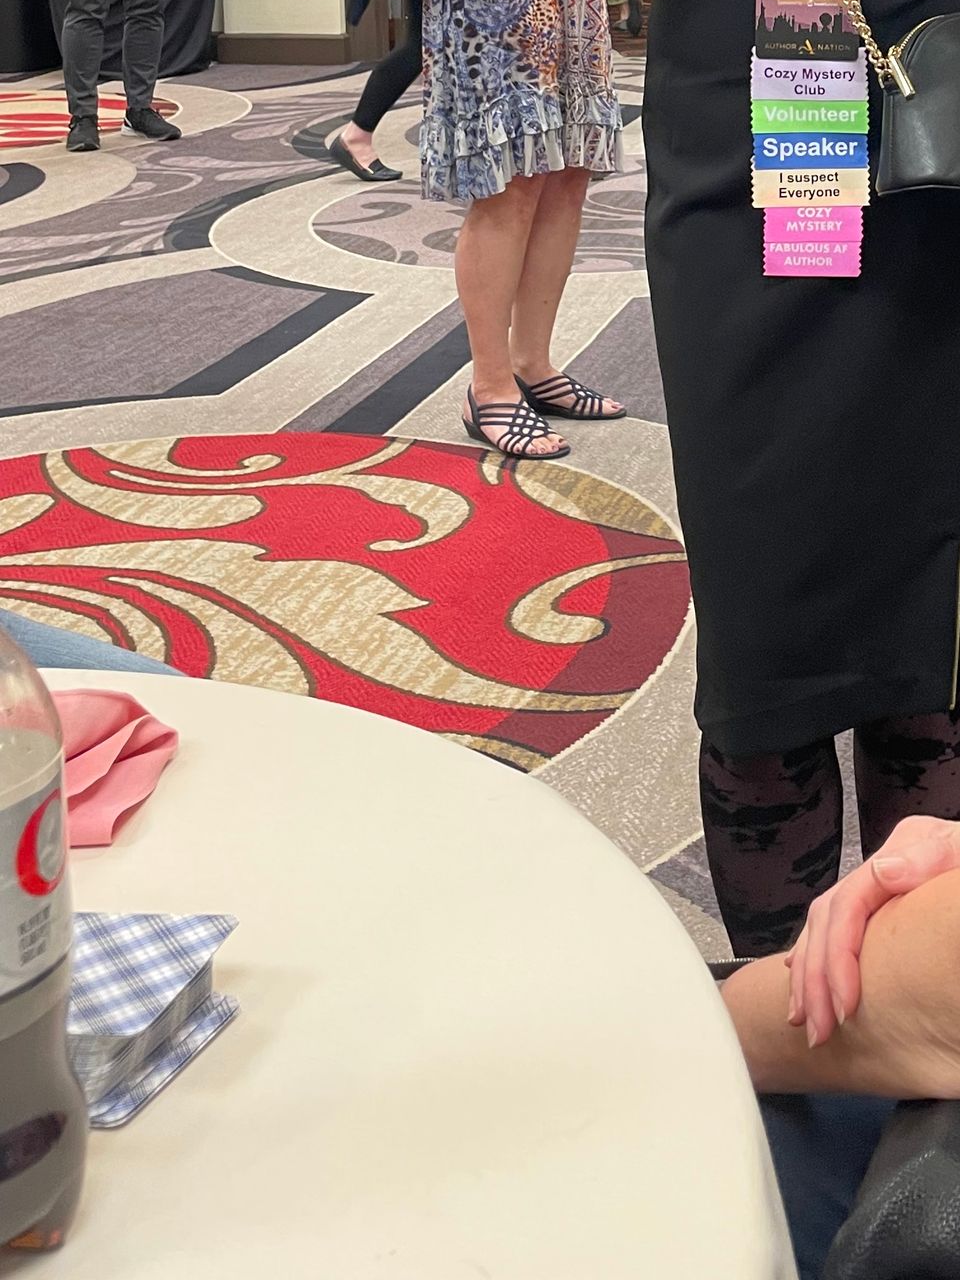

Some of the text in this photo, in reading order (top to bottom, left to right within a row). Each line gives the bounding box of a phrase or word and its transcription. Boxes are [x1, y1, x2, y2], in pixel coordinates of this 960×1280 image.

[764, 42, 797, 50] AUTHOR
[817, 43, 850, 51] NATION
[764, 67, 856, 81] Cozy Mystery
[794, 84, 826, 96] Club
[764, 106, 859, 122] Volunteer
[763, 138, 858, 161] Speaker
[787, 172, 839, 185] suspect
[779, 188, 840, 200] Everyone
[796, 207, 833, 218] COZY
[786, 221, 843, 231] MYSTERY
[769, 243, 830, 254] FABULOUS
[783, 256, 833, 267] AUTHOR
